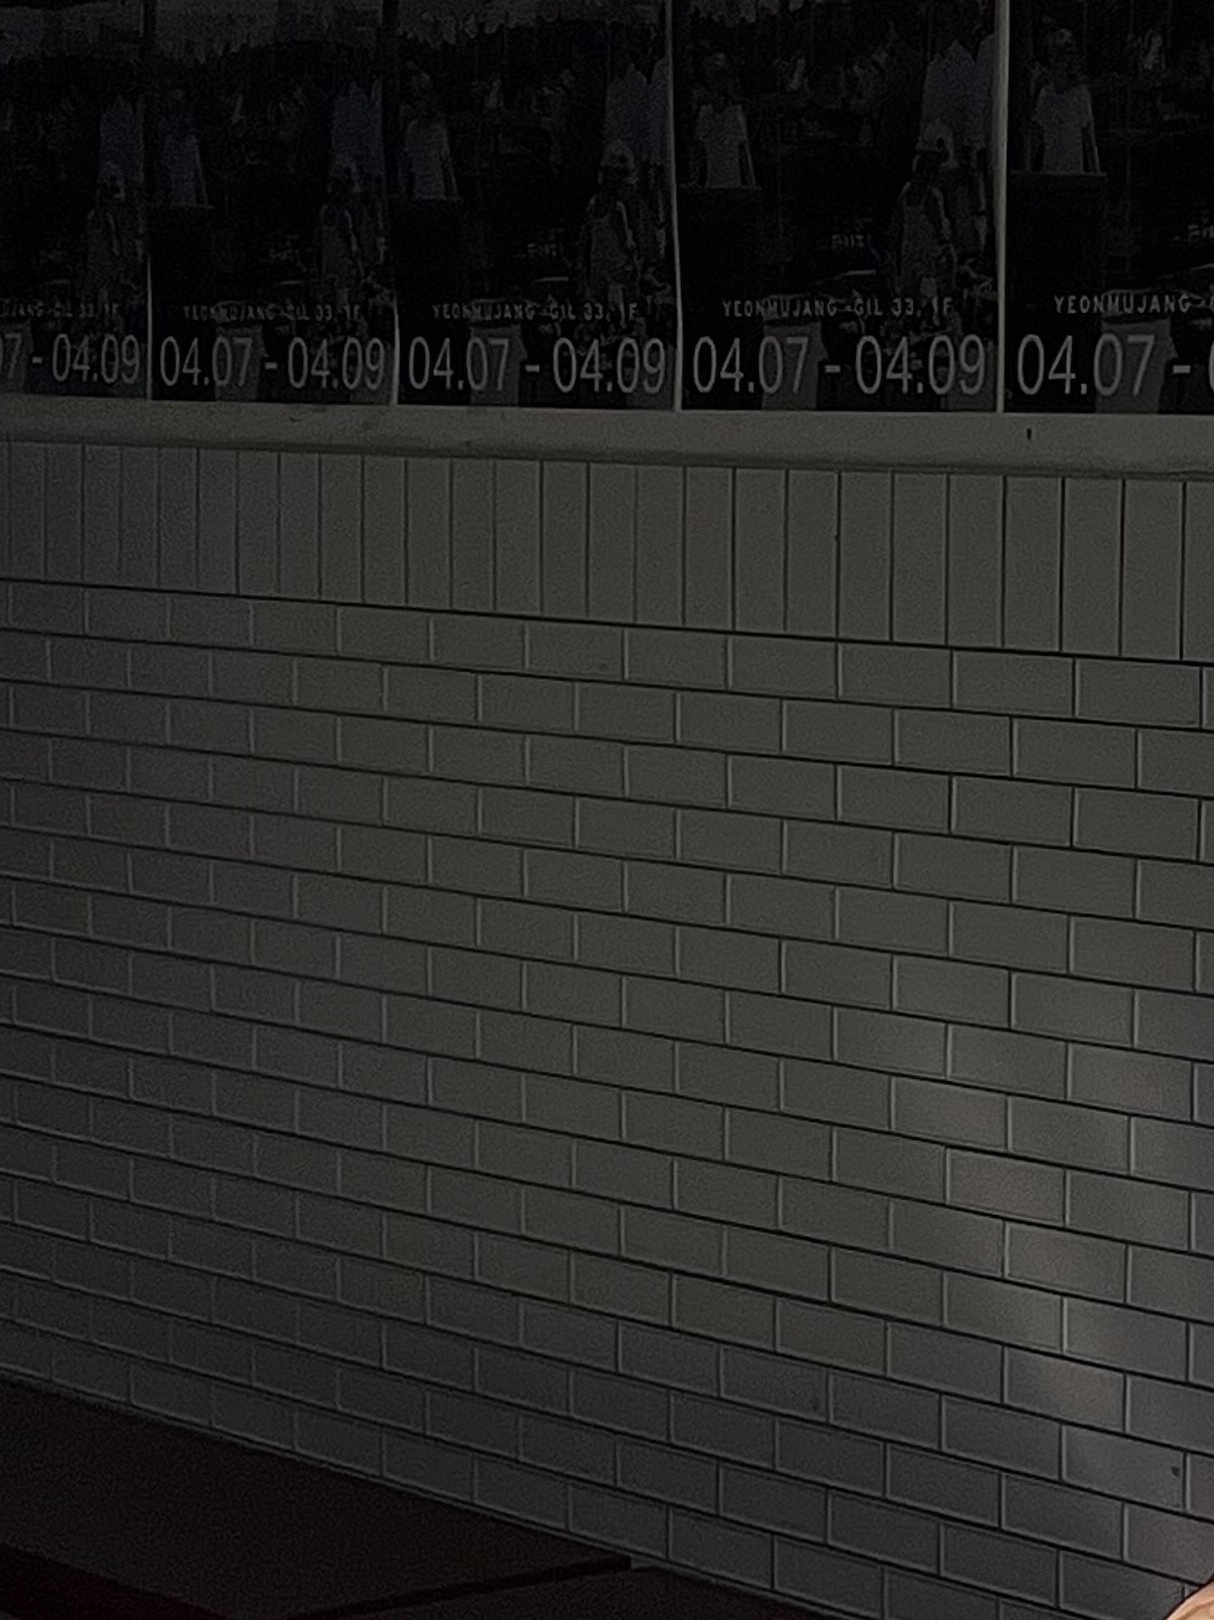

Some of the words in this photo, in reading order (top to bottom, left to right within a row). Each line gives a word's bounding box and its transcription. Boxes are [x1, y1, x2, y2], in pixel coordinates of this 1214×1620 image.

[52, 332, 140, 385] 04.09
[160, 335, 252, 386] 04.07
[288, 337, 384, 391] 04.09
[408, 335, 510, 391] 04.07
[552, 337, 666, 395] 04.09
[693, 335, 810, 394] 04.07
[855, 333, 986, 396] 04.09
[1016, 333, 1156, 397] 04.07
